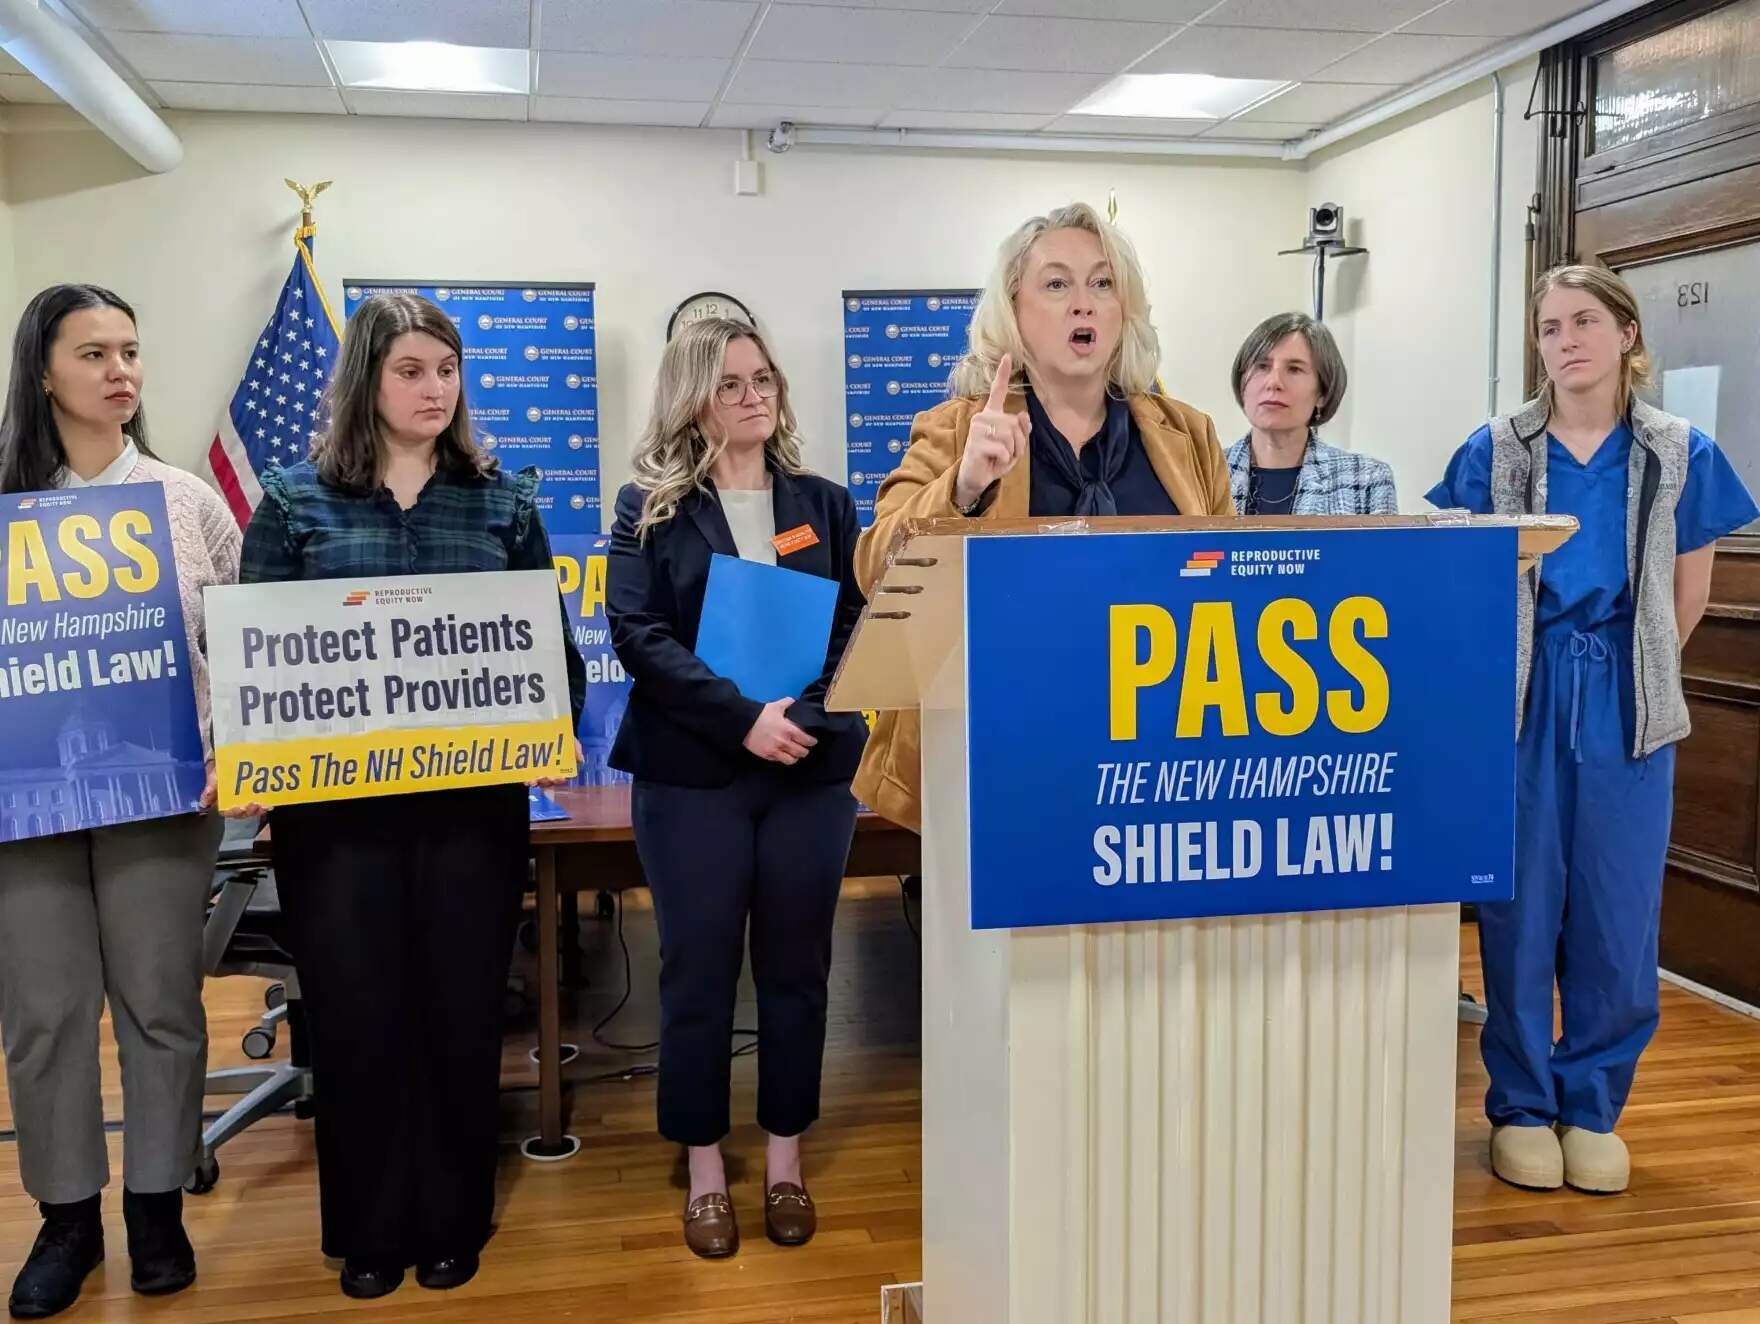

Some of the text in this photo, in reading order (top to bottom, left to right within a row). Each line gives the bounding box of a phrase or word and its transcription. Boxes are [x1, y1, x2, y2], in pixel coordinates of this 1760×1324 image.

[694, 308, 702, 318] 11
[706, 304, 718, 314] 12
[725, 309, 728, 318] 1
[0, 510, 160, 605] ASS
[1231, 549, 1320, 561] REPRODUCTIVE
[1231, 564, 1304, 576] EQUITY NOW
[375, 588, 432, 596] REPRODUCTIVE
[552, 555, 607, 617] PA
[1, 602, 166, 645] New Hampshire
[242, 613, 533, 669] Protect Patients
[575, 625, 607, 645] New
[0, 640, 177, 698] ield Law!
[581, 653, 626, 683] eld
[1108, 596, 1390, 741] PASS
[240, 668, 546, 726] Protect Providers
[234, 733, 564, 796] Pass The NH Shield Law!
[1096, 752, 1398, 805] THE NEW HAMPSHIRE
[1092, 812, 1393, 886] SHIELD LAW!
